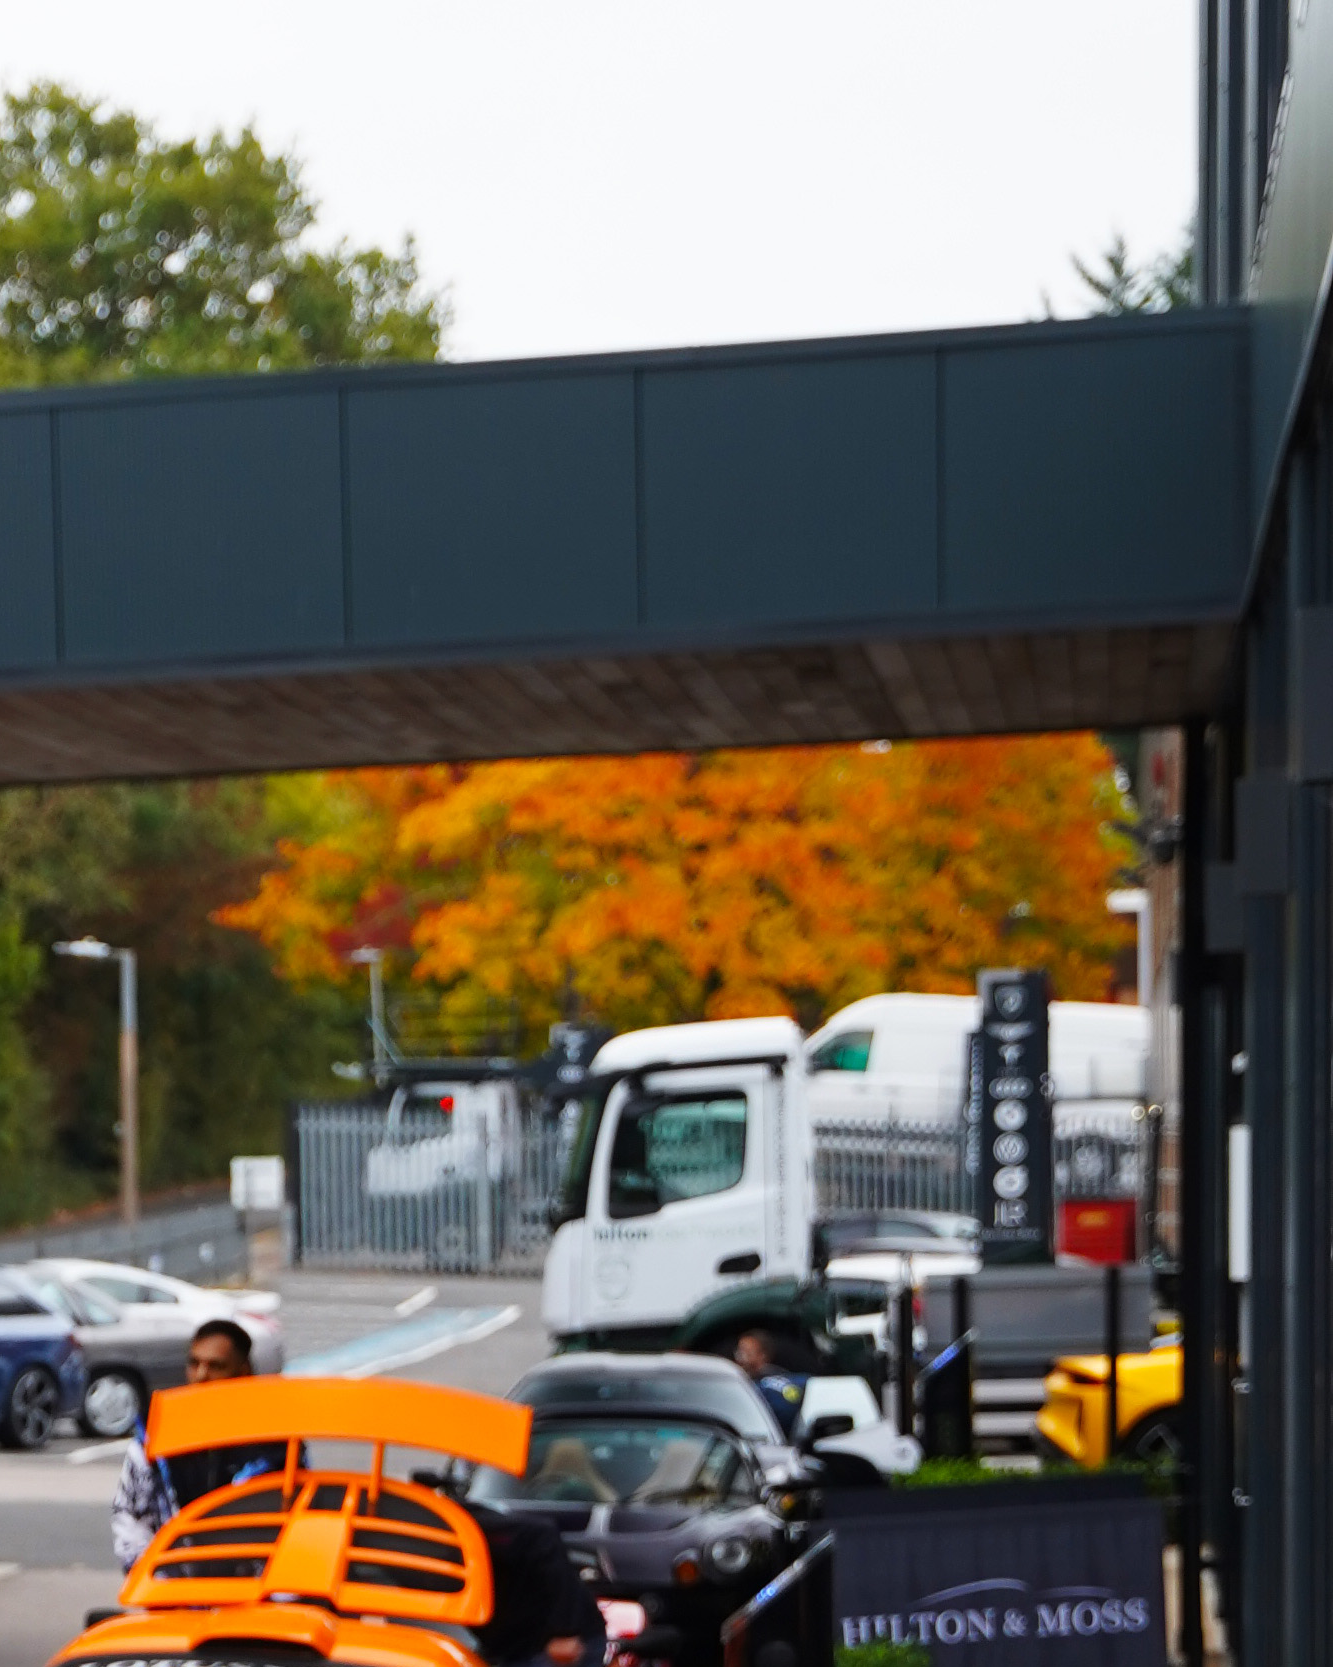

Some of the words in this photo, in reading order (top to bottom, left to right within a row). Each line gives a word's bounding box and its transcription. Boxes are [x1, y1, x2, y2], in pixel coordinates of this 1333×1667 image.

[840, 1607, 997, 1649] HILTON
[1002, 1608, 1029, 1638] &
[1036, 1597, 1150, 1639] MOSS
